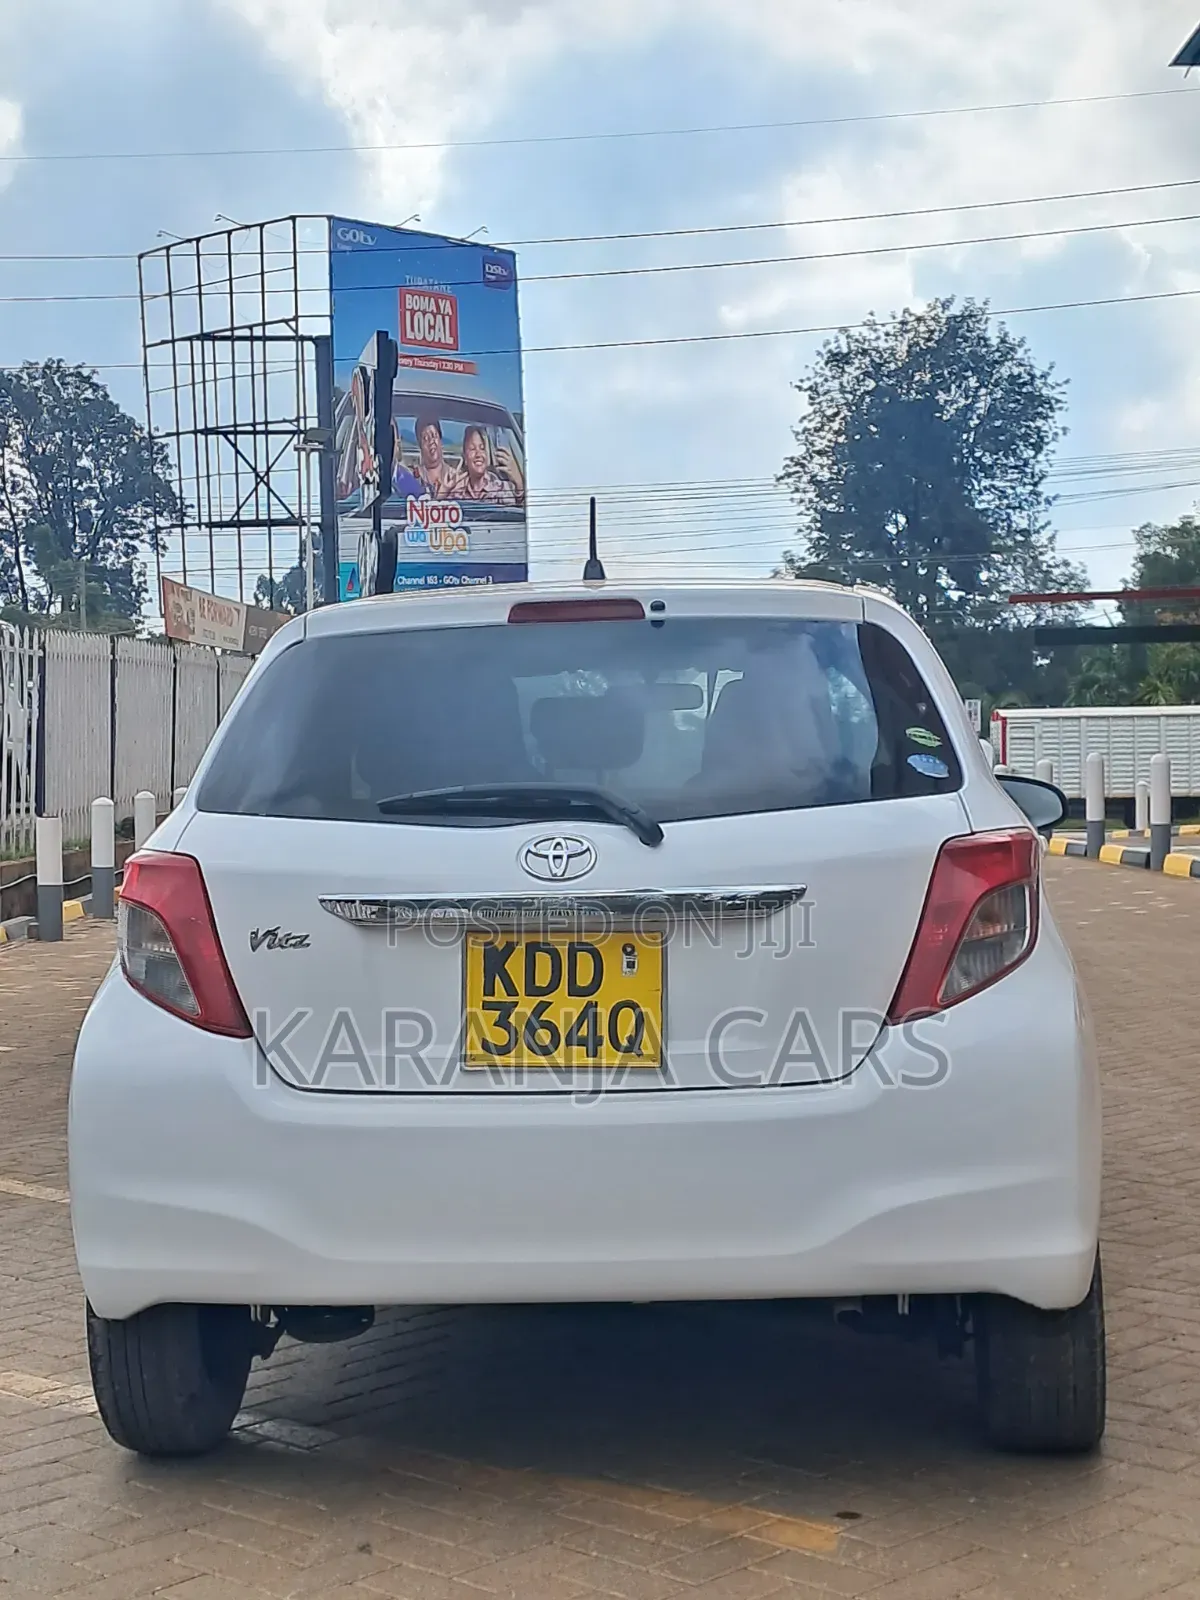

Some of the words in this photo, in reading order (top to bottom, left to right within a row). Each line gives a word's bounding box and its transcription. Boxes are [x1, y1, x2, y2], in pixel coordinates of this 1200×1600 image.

[337, 227, 377, 246] GOtv
[485, 263, 510, 276] DStv
[405, 293, 437, 313] BOMA
[438, 299, 453, 316] YA
[405, 312, 454, 345] LOCAL
[408, 497, 460, 530] Njoro
[407, 530, 427, 543] wa
[429, 528, 467, 552] Uba
[397, 575, 425, 585] Channel
[460, 575, 487, 585] Channel
[249, 925, 312, 953] Vitz
[482, 941, 604, 998] KDD
[481, 1000, 646, 1058] 364Q
